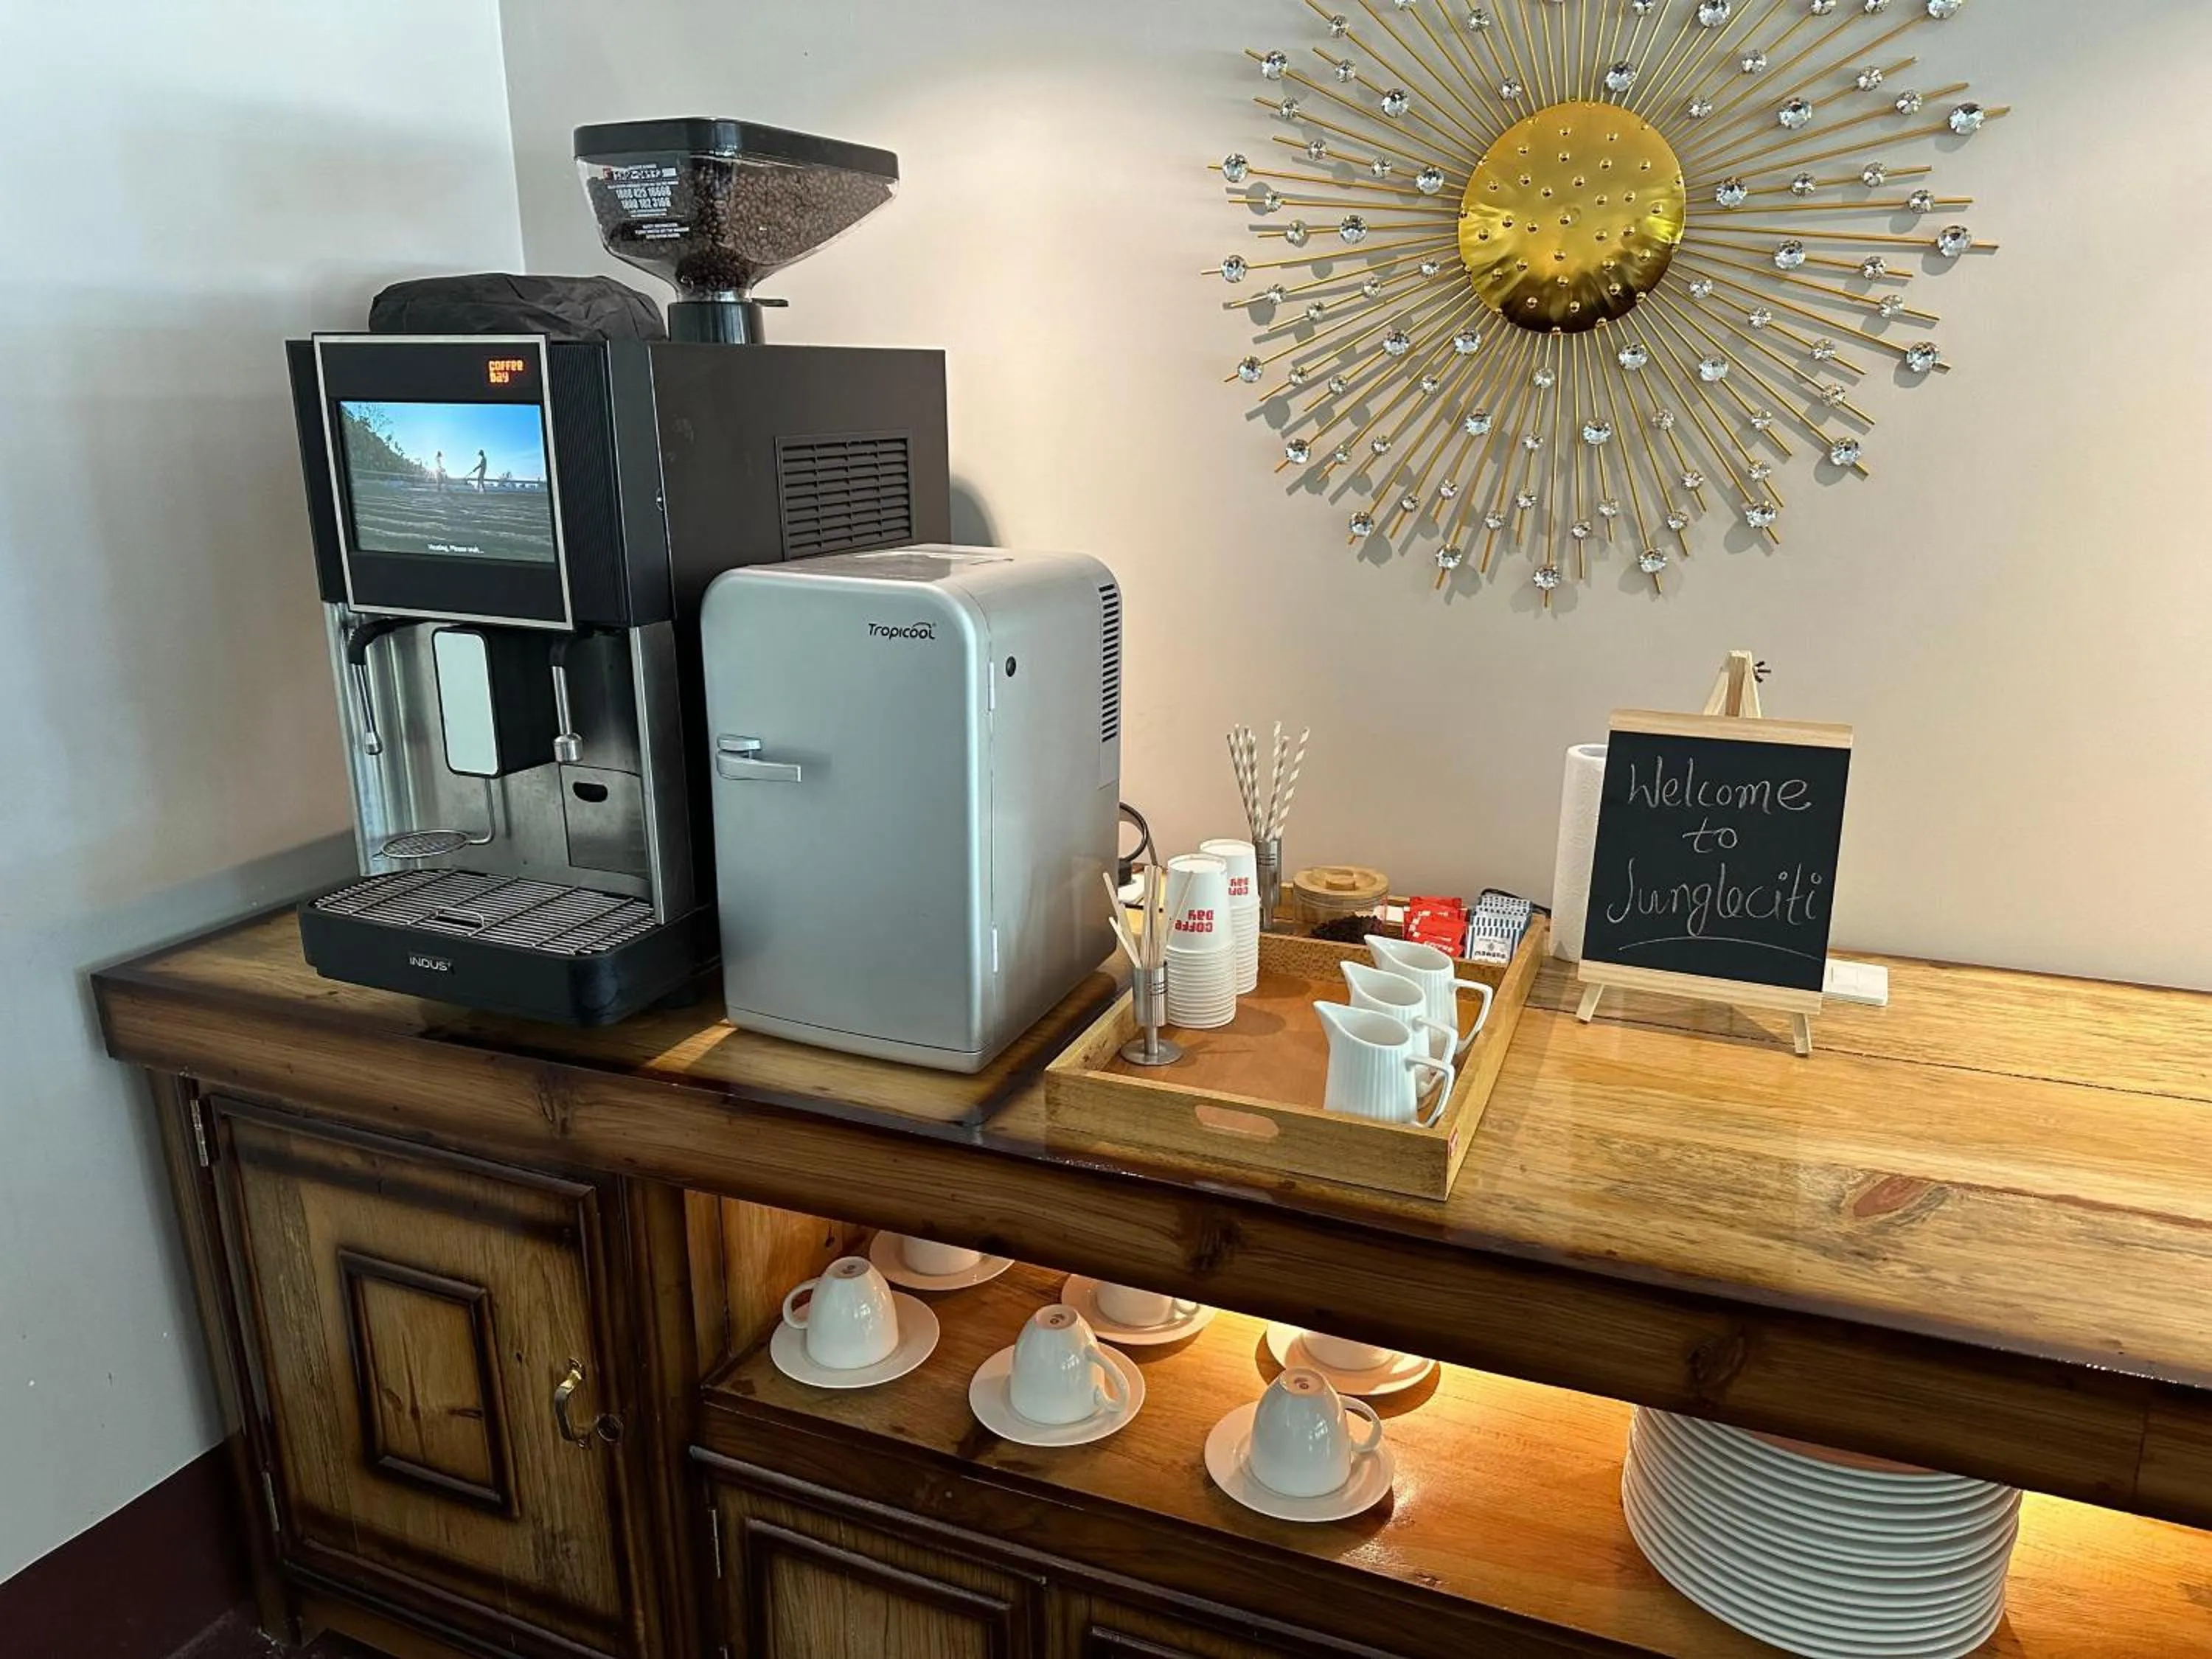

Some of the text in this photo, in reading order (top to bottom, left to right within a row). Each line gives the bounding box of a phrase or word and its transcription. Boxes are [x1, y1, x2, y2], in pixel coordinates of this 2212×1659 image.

[868, 621, 935, 640] Tropicool
[1628, 754, 1812, 815] Welcome
[1682, 816, 1738, 853] to
[1606, 856, 1823, 937] Jungleciti
